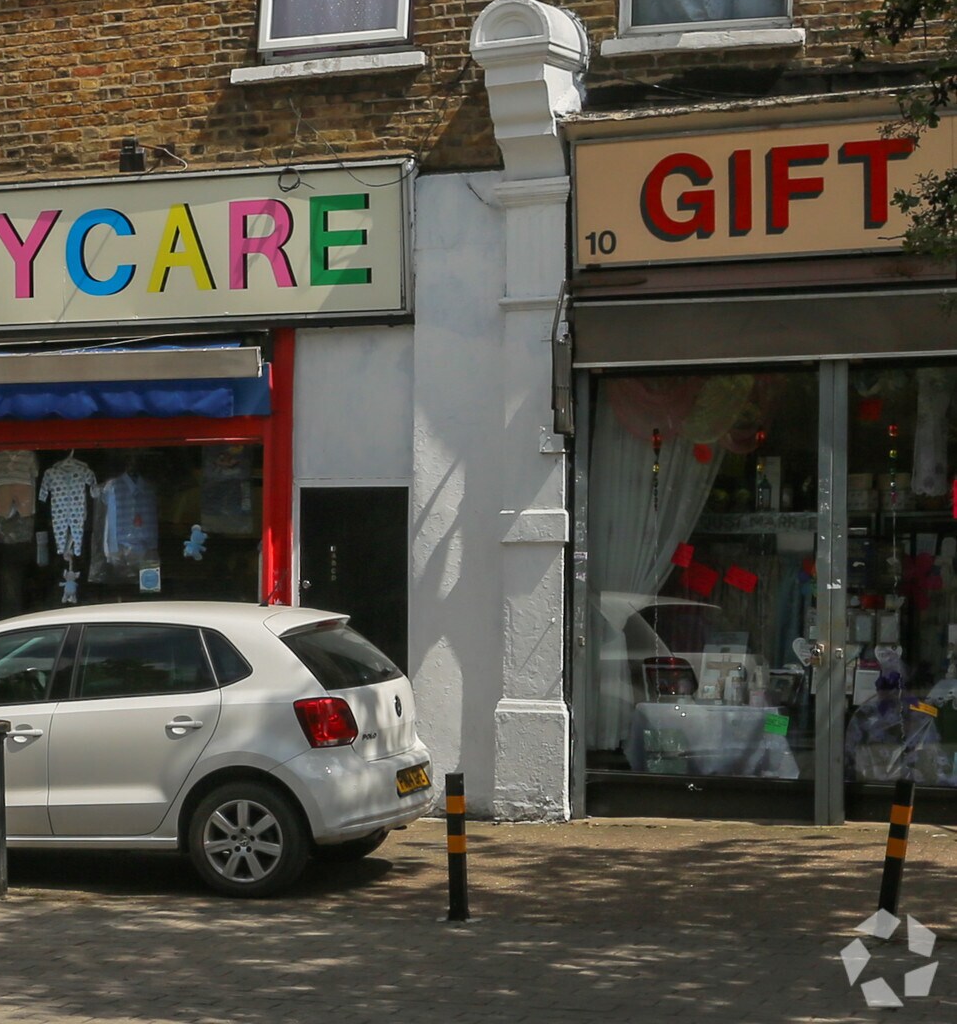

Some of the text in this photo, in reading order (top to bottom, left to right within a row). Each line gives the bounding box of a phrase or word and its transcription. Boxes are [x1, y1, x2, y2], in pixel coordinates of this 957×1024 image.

[640, 137, 914, 242] GIFT
[585, 230, 617, 255] 10
[362, 732, 377, 741] POLO
